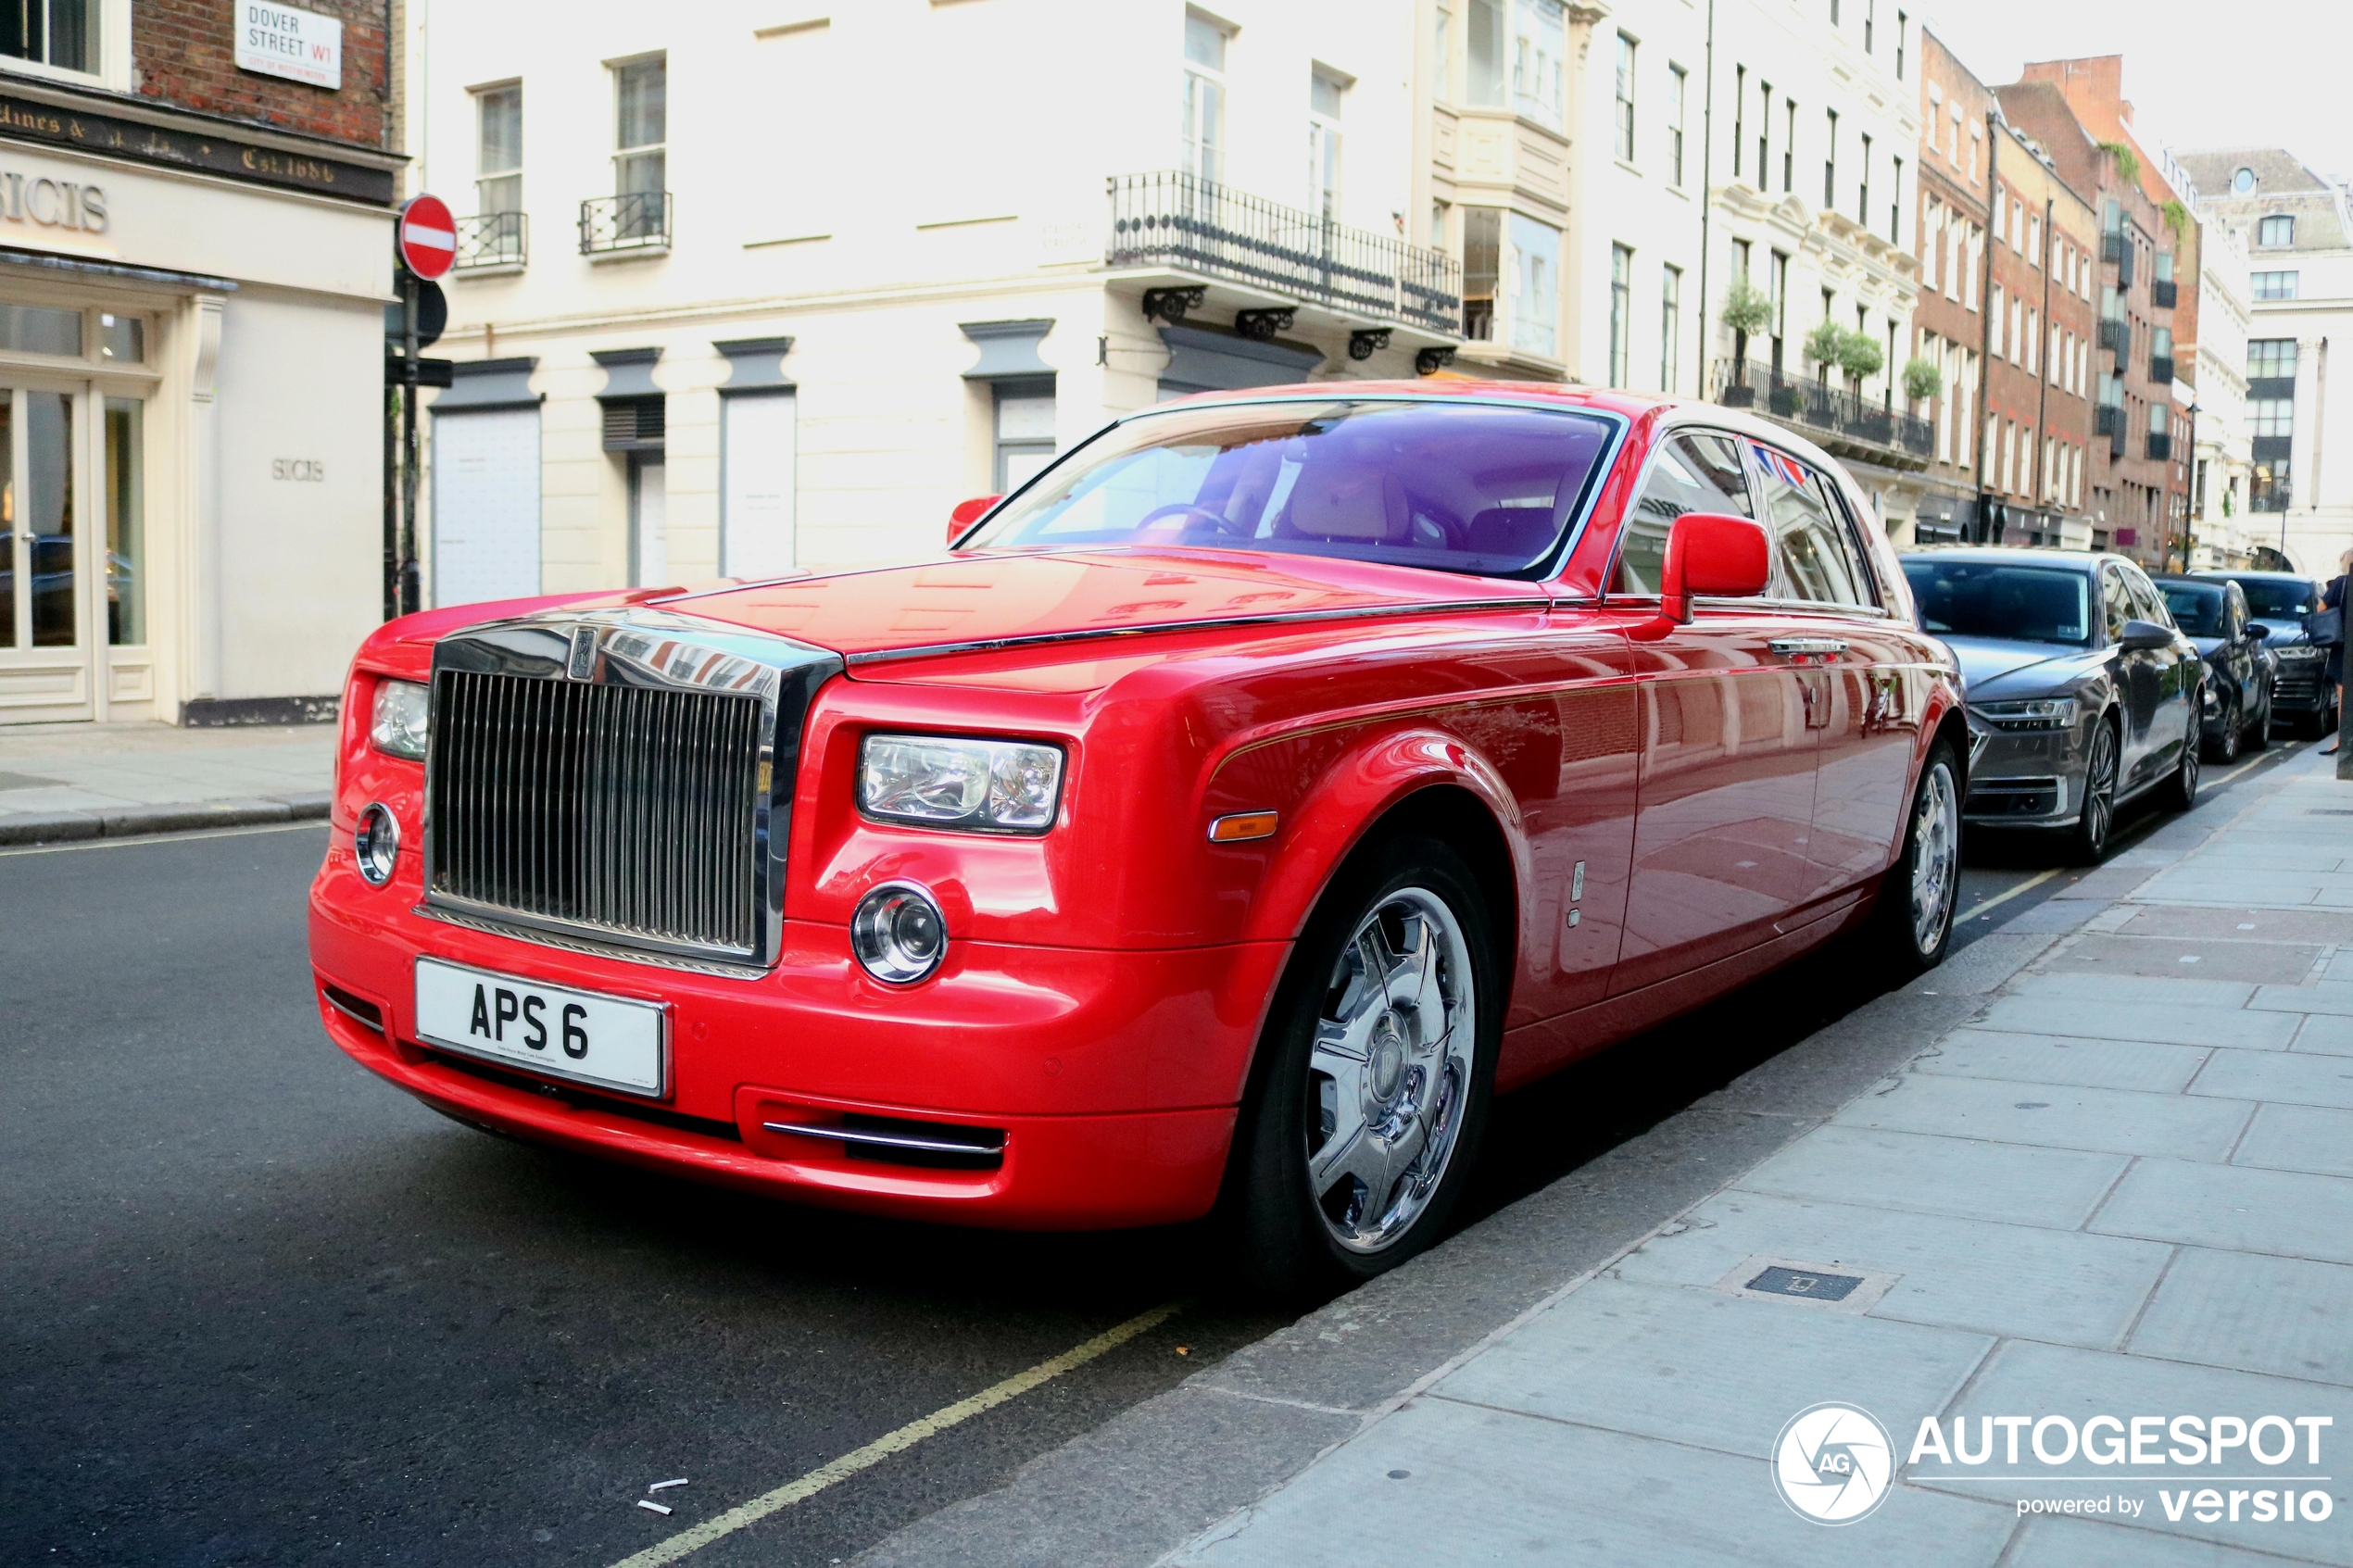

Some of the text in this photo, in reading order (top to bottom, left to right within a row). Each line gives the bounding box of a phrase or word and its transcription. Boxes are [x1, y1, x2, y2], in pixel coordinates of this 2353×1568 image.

[249, 6, 298, 33] DOVER
[249, 29, 331, 63] STREET W1
[248, 56, 327, 81] CITY OF WESTMINSTER
[0, 170, 109, 235] ICIS
[272, 458, 323, 482] SICIS
[470, 984, 588, 1060] APS 6
